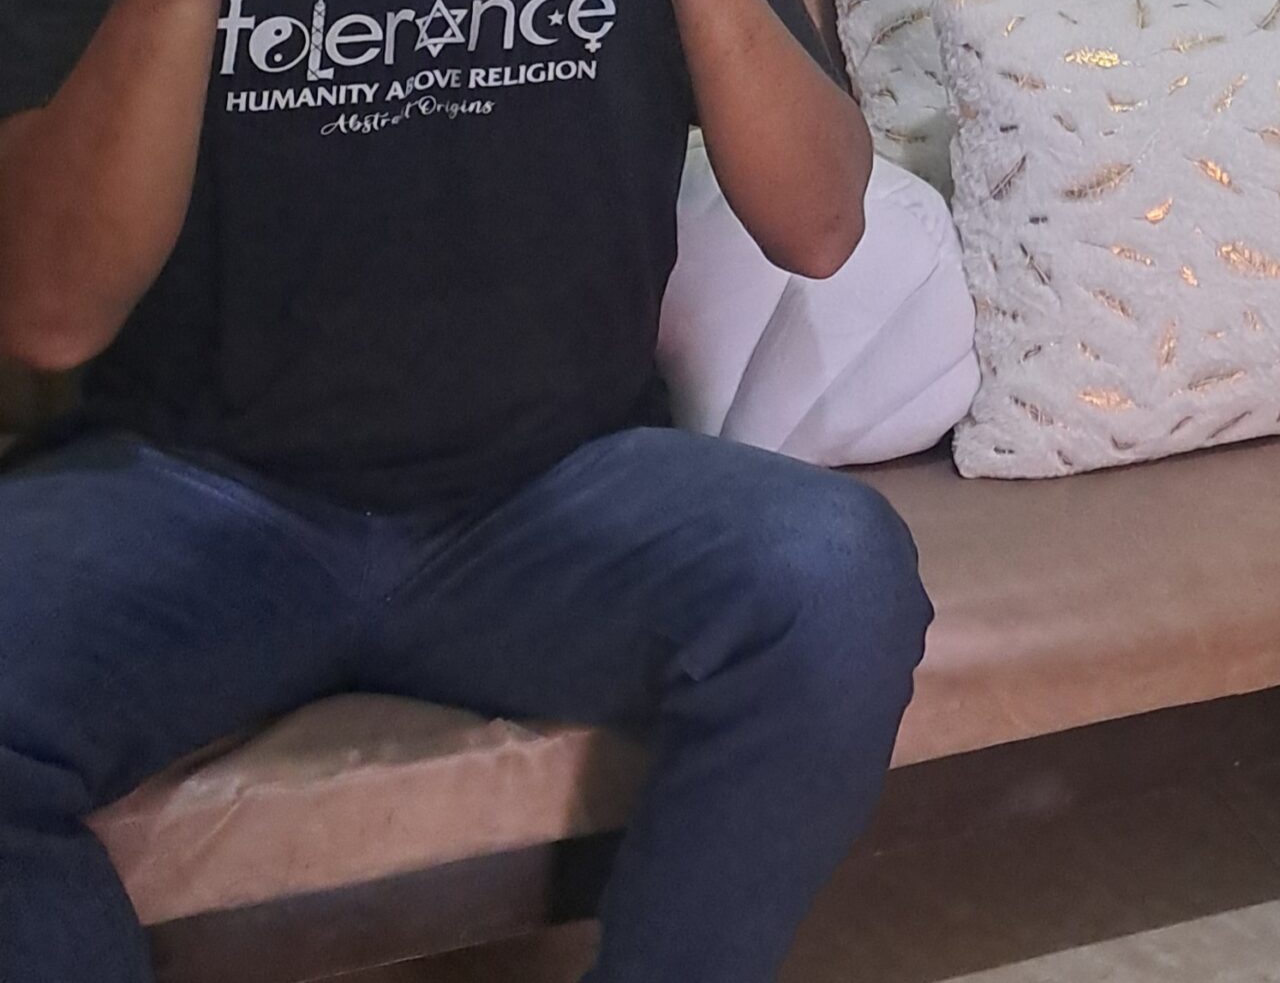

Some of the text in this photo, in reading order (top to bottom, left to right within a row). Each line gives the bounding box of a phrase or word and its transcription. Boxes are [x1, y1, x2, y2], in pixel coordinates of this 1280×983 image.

[226, 82, 380, 112] HUMANITY
[468, 60, 598, 89] RELIGION
[417, 95, 496, 120] Origins
